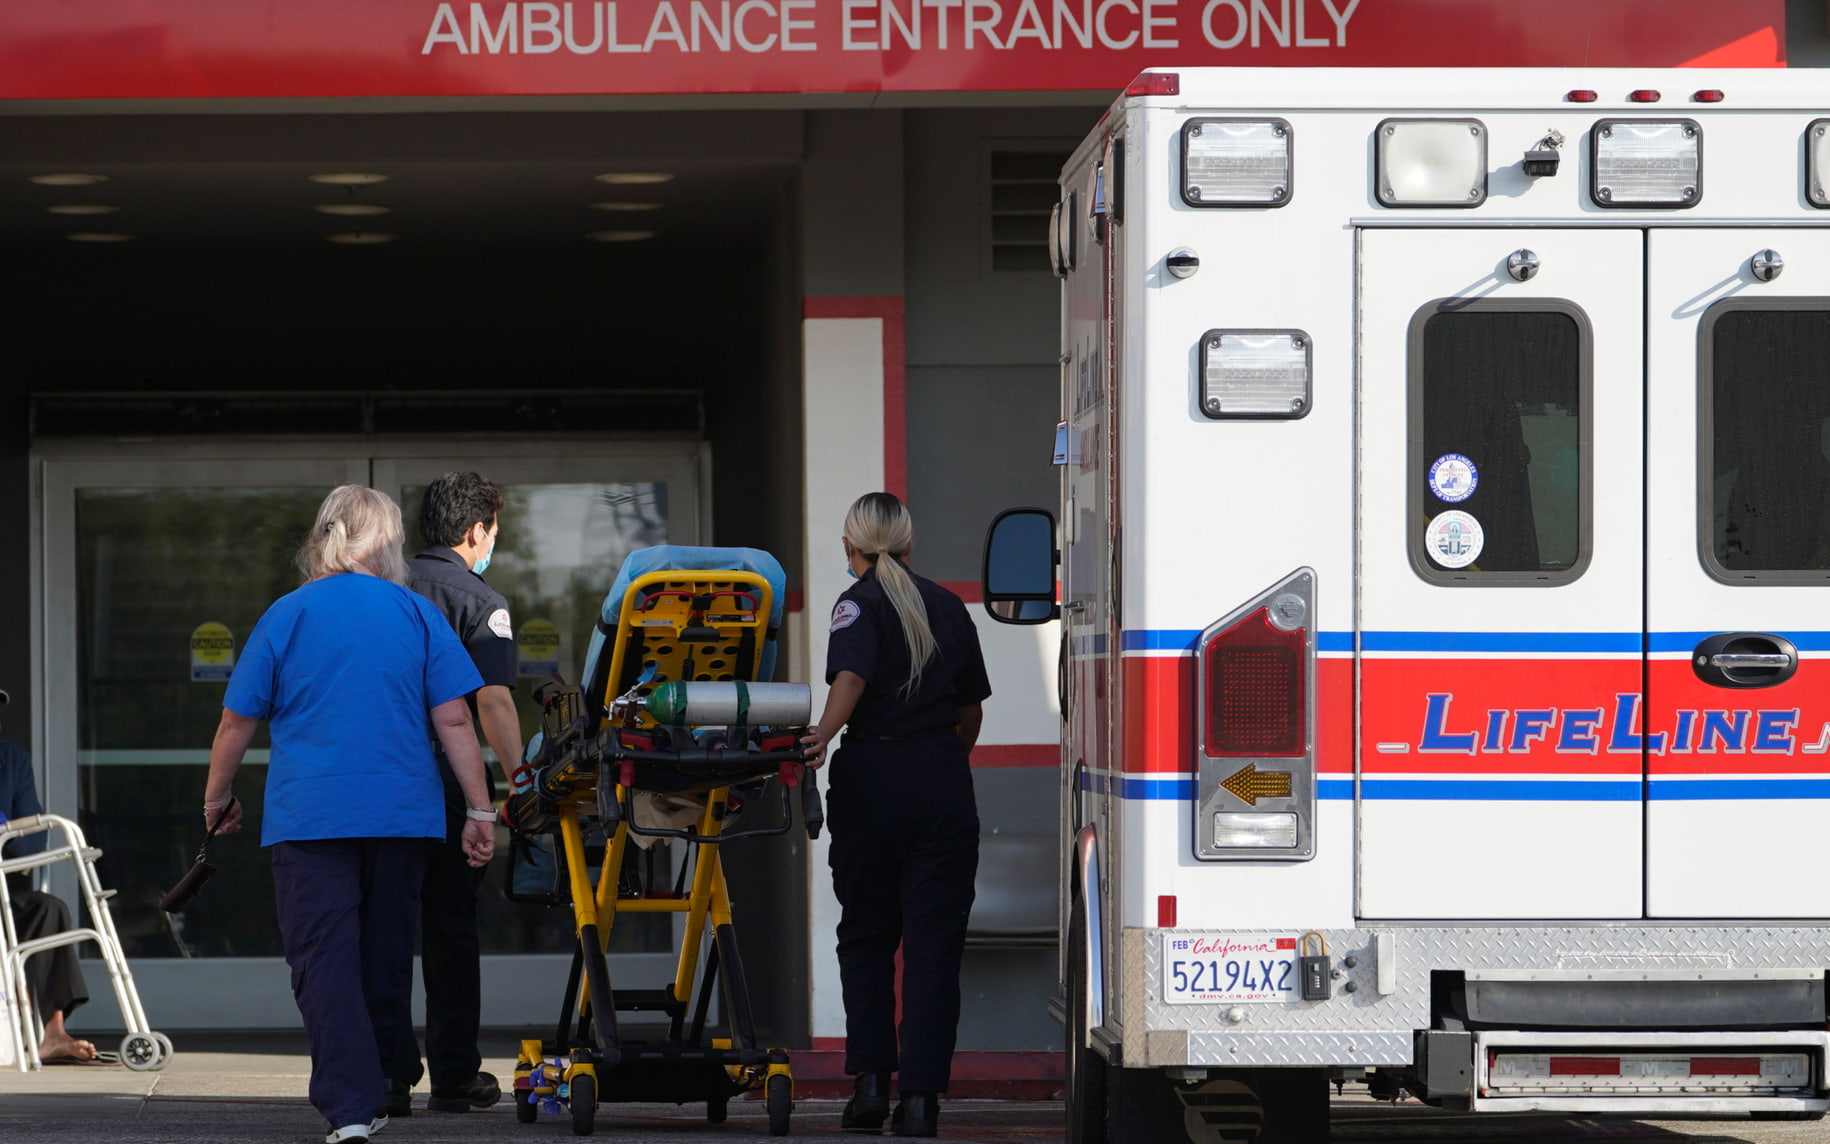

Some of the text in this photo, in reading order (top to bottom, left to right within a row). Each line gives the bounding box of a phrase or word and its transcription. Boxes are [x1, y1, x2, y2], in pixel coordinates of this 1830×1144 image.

[421, 0, 1360, 55] AMBULANCE ENTRANCE ONLY
[1172, 940, 1189, 950] FEB
[1192, 938, 1278, 958] California
[1173, 960, 1293, 992] 52194X2
